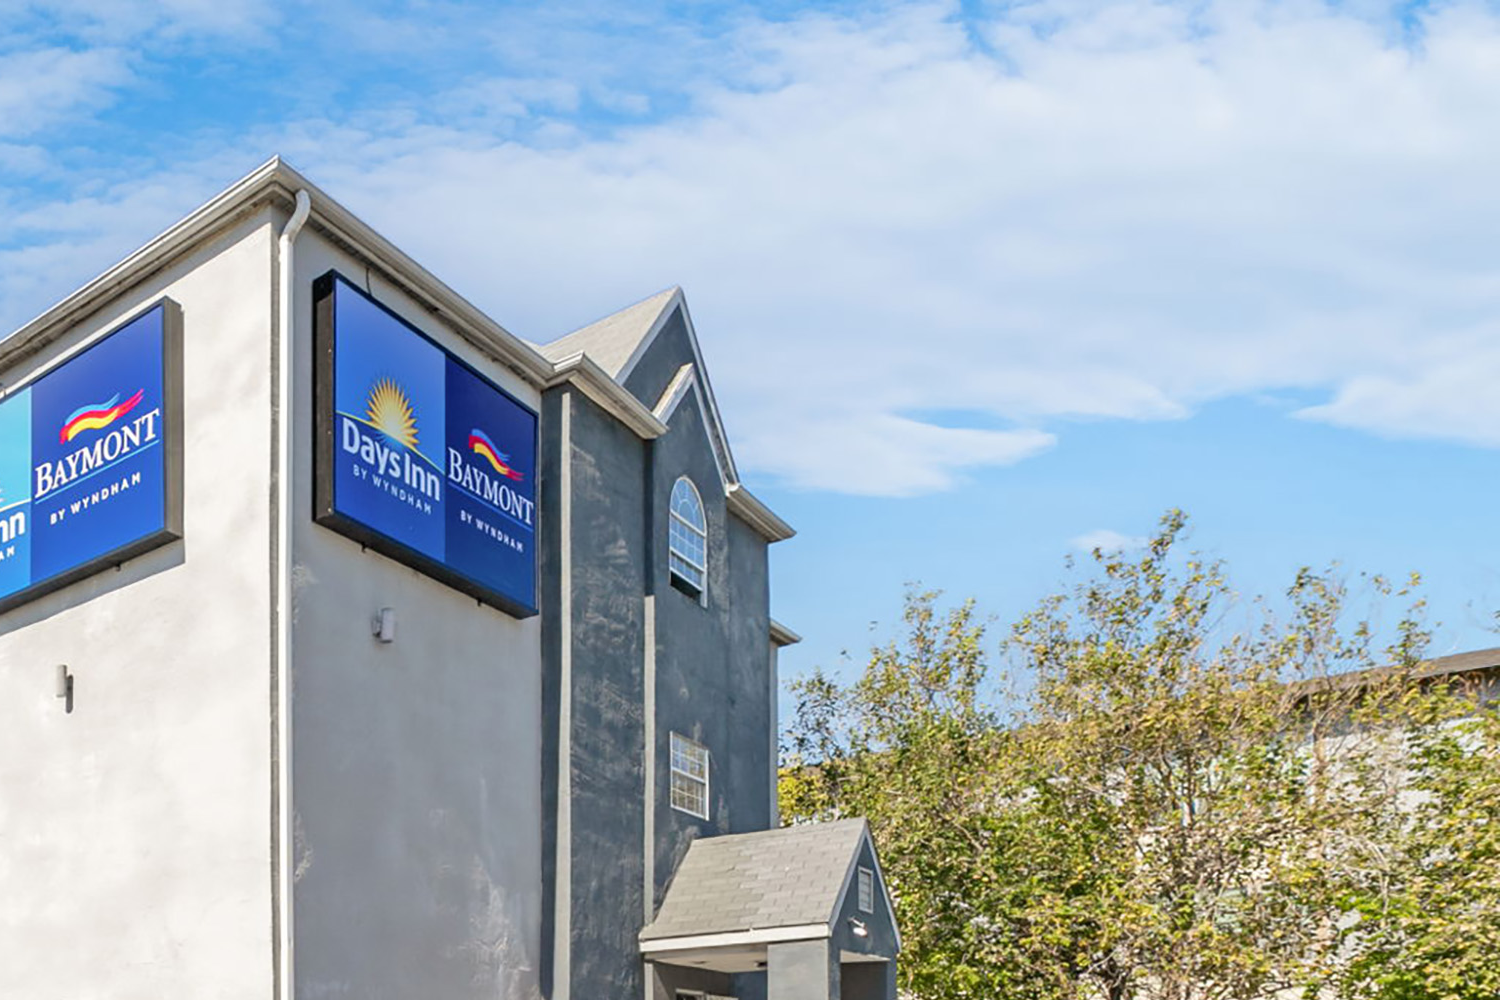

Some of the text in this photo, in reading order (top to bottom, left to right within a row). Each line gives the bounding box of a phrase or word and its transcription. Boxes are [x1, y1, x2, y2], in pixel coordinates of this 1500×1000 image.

[34, 408, 160, 499] BAYMONT
[342, 417, 441, 502] Days Inn
[447, 446, 534, 525] BAYMONT
[50, 471, 141, 525] BY WYNDHAM
[353, 464, 432, 515] BY WYNDHAM
[460, 509, 524, 553] BY WYNDHAM
